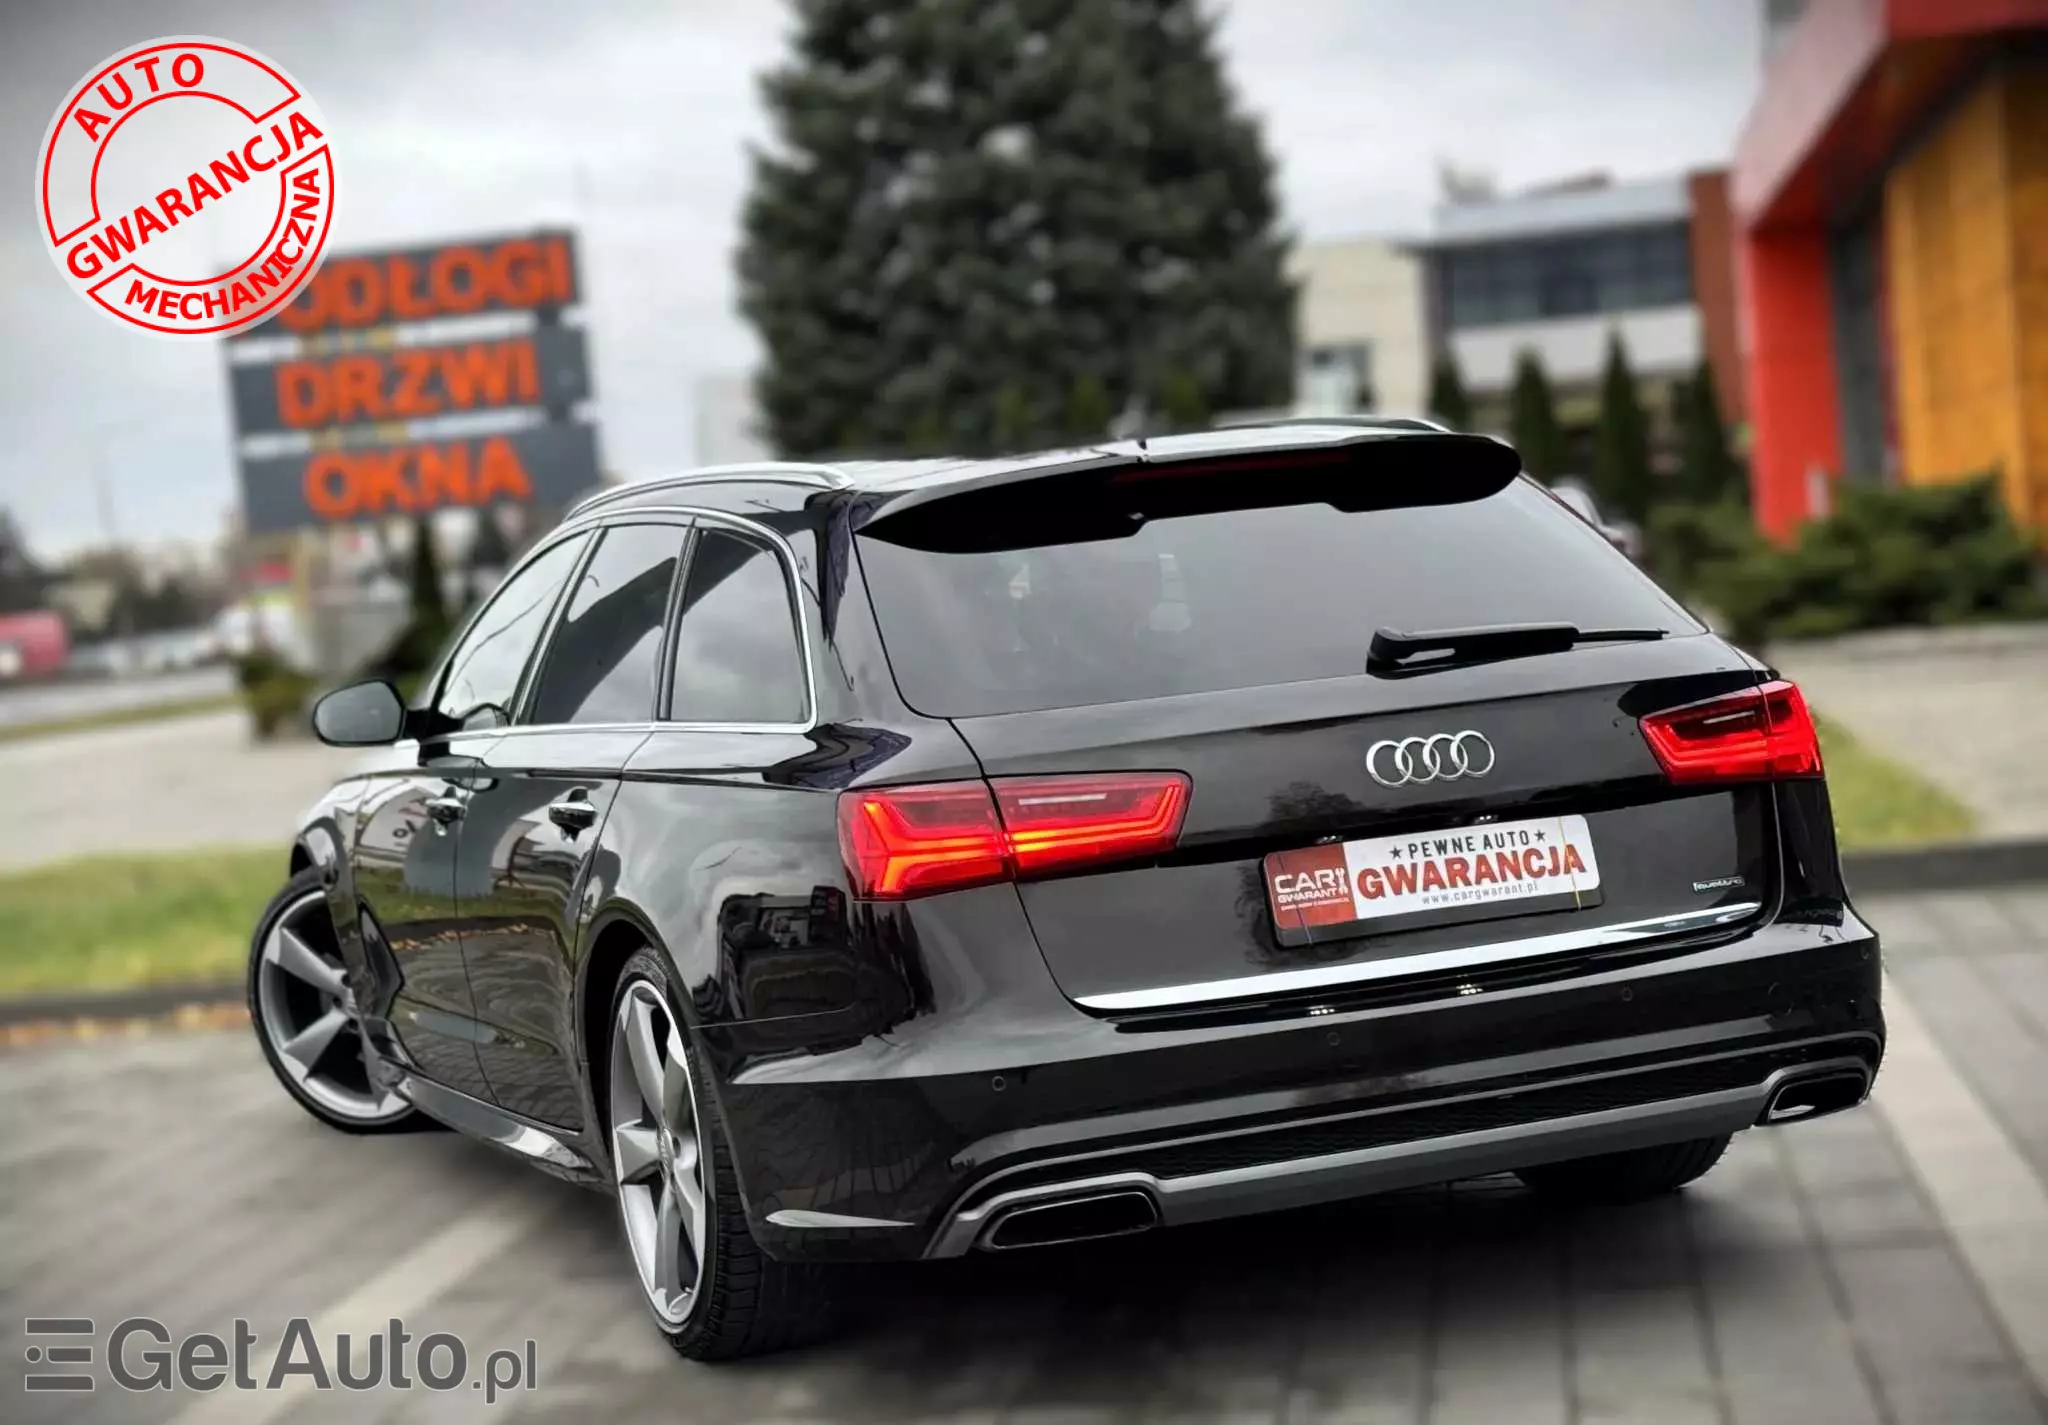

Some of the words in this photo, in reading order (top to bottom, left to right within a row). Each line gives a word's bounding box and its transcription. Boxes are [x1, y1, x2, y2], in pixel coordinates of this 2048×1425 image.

[272, 240, 569, 331] ODŁOGI
[276, 338, 539, 428] DRZWI
[305, 436, 531, 518] OKNA
[1357, 844, 1587, 900] GWARANCJA
[1408, 836, 1475, 860] PEWNE
[1483, 830, 1530, 850] AUTO
[1275, 868, 1337, 893] CAR
[1422, 881, 1538, 905] www.cargwarant.pl
